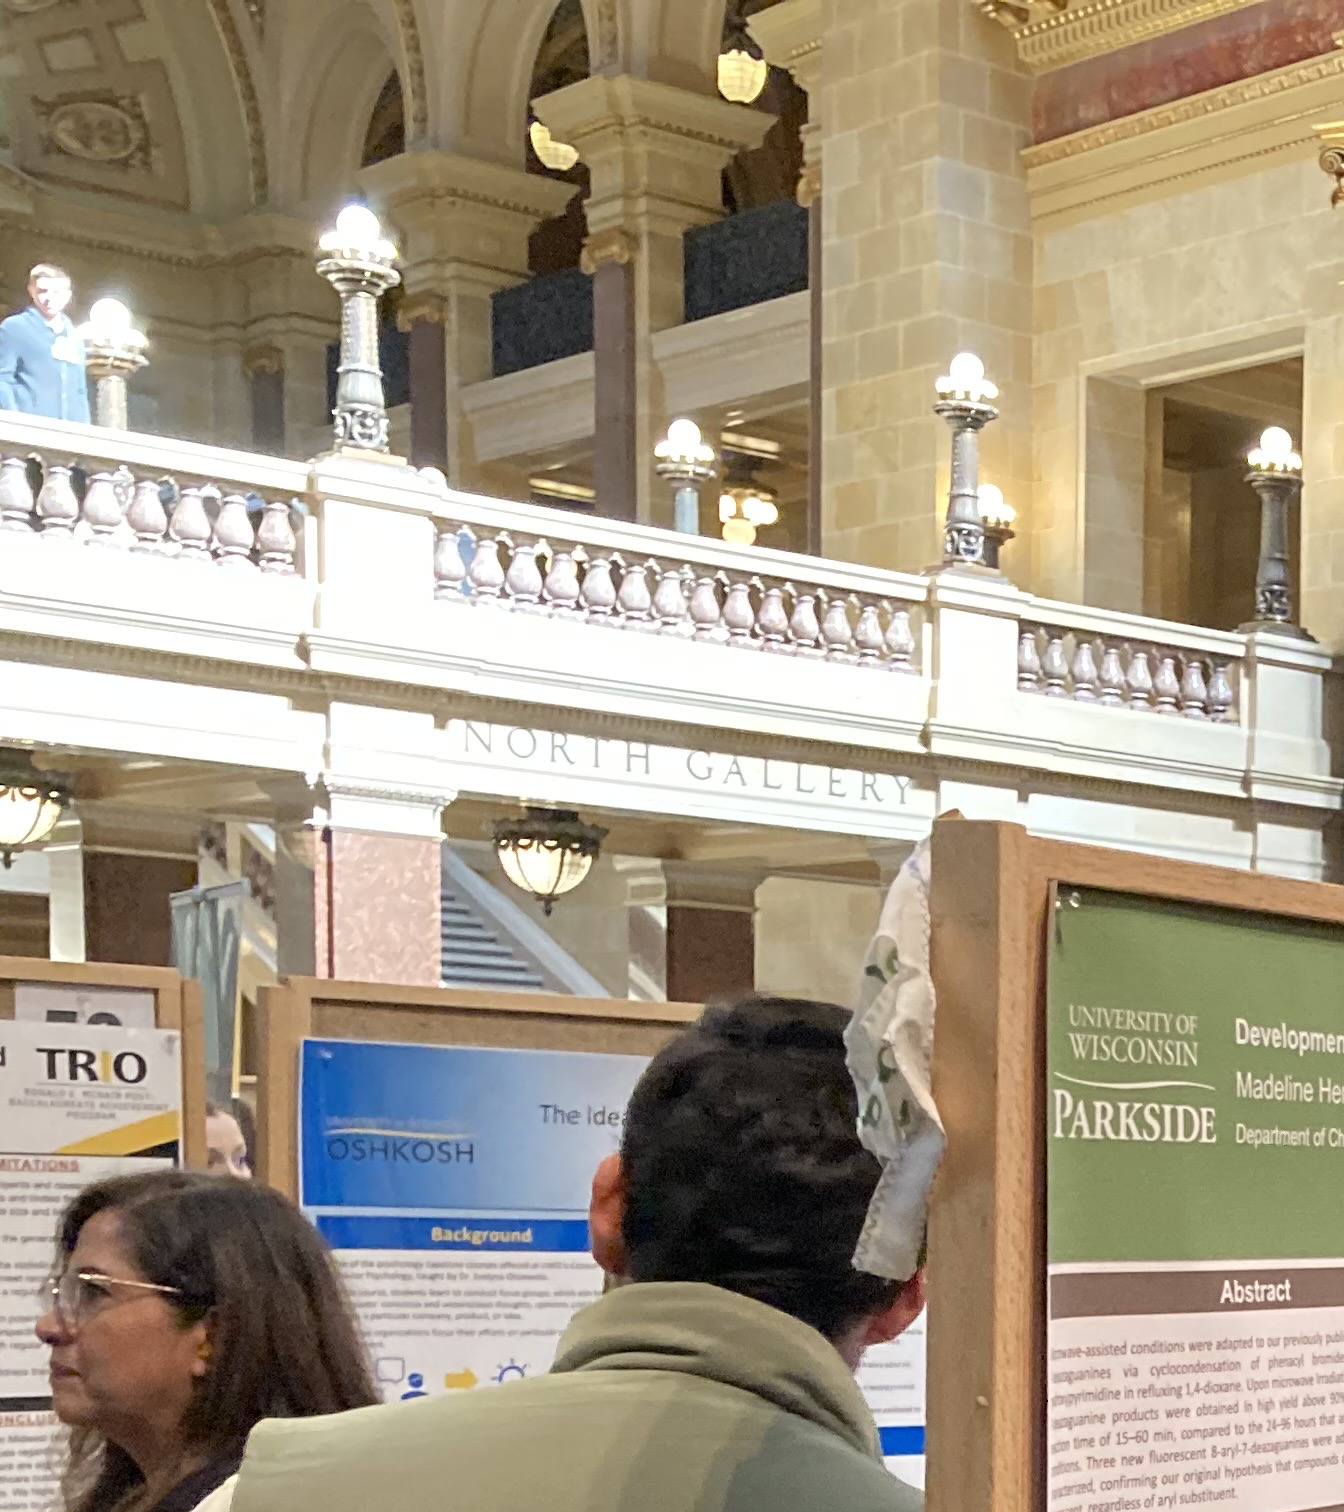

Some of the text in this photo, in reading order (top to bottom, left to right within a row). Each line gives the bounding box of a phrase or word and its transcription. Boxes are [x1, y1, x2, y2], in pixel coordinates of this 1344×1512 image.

[463, 719, 913, 804] NORTH GALLERY
[1069, 1004, 1198, 1035] UNIVERSITY OF
[1068, 1032, 1198, 1066] WISCONSIN
[36, 1048, 147, 1084] TRIO
[1236, 1071, 1314, 1102] Madeline
[539, 1103, 581, 1126] The
[1053, 1089, 1217, 1143] PARKSIDE
[1236, 1123, 1310, 1149] Department
[1313, 1127, 1326, 1147] of
[327, 1137, 475, 1164] OSHKOSH
[431, 1226, 533, 1245] Background
[1220, 1280, 1291, 1304] Abstract
[1131, 1336, 1280, 1355] conditions were to our
[1123, 1364, 1138, 1378] via
[1150, 1359, 1241, 1379] cyclocondensation
[1251, 1356, 1260, 1370] of
[1124, 1387, 1134, 1399] in
[1137, 1384, 1182, 1399] refluxing
[1247, 1377, 1270, 1392] Upon
[1112, 1409, 1159, 1425] products
[1165, 1406, 1191, 1419] were
[1196, 1401, 1239, 1417] obtained
[1099, 1420, 1262, 1446] of min, compared to the
[1086, 1449, 1206, 1470] Three new fluorescent
[1100, 1460, 1273, 1492] confirming our original hypothesis
[1144, 1495, 1155, 1509] of
[1157, 1494, 1177, 1510] aryl
[1179, 1487, 1238, 1503] substituent.
